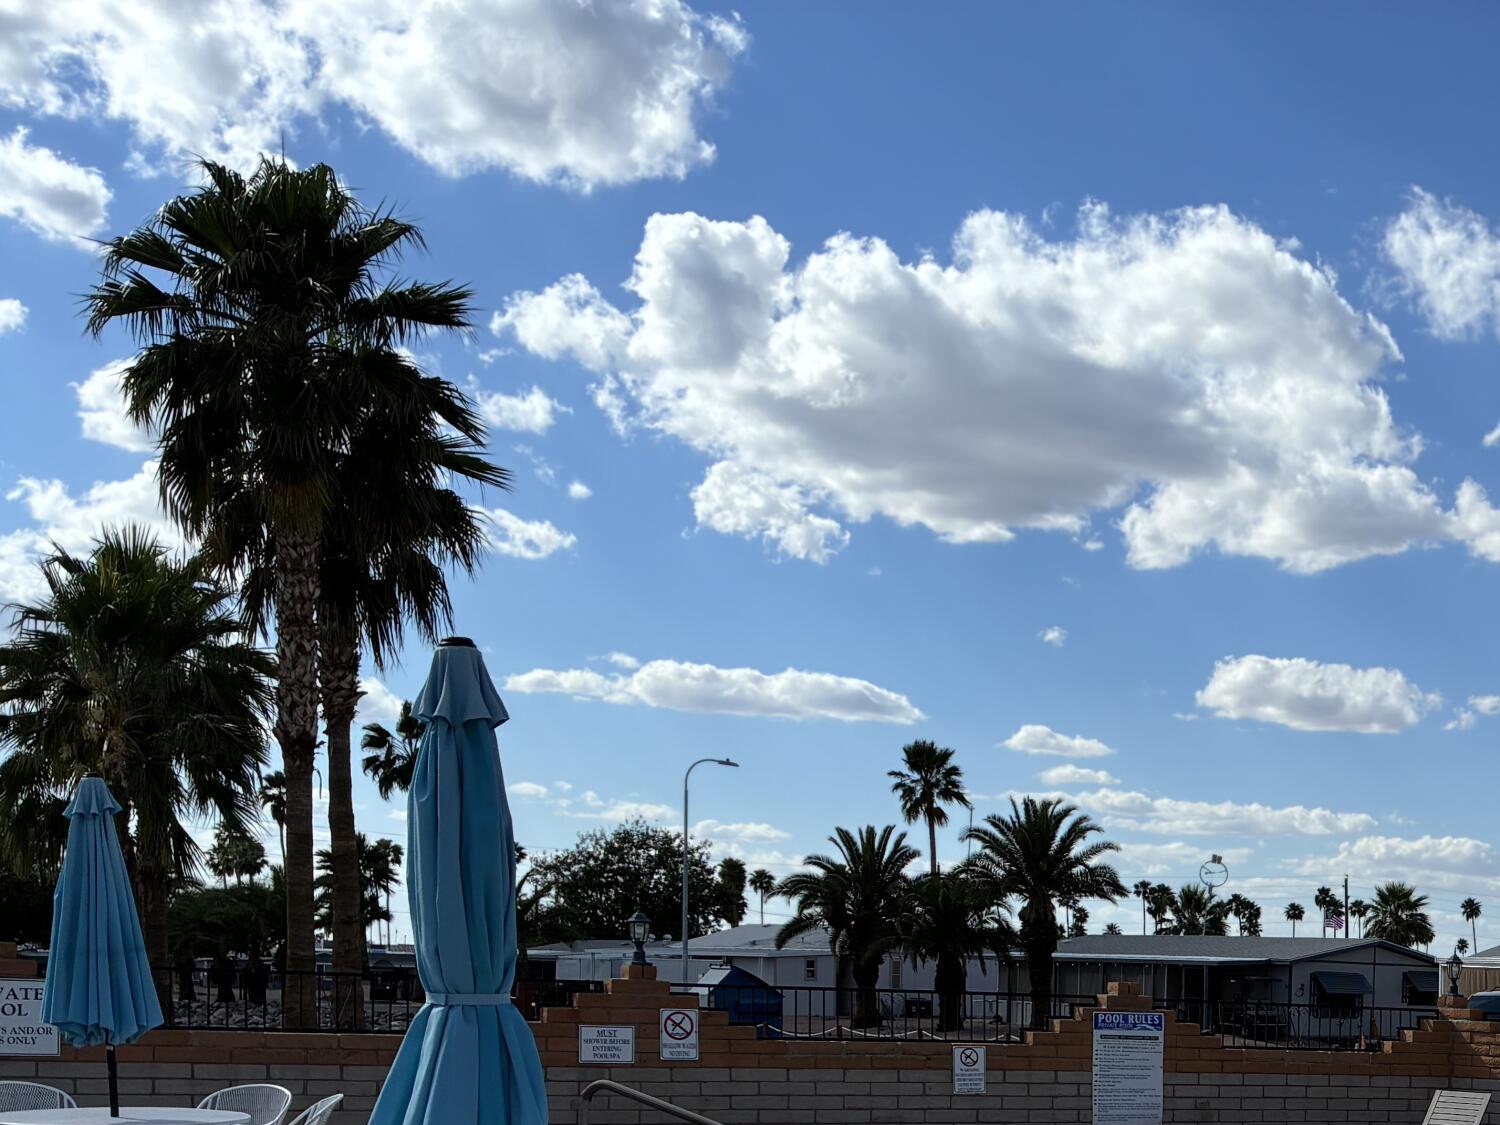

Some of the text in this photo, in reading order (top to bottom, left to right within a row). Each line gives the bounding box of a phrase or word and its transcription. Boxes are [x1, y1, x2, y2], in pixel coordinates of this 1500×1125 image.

[0, 987, 44, 1001] ATE
[1097, 1013, 1160, 1025] POOL RULES
[596, 1029, 617, 1038] MUST
[7, 1036, 37, 1045] ONLY
